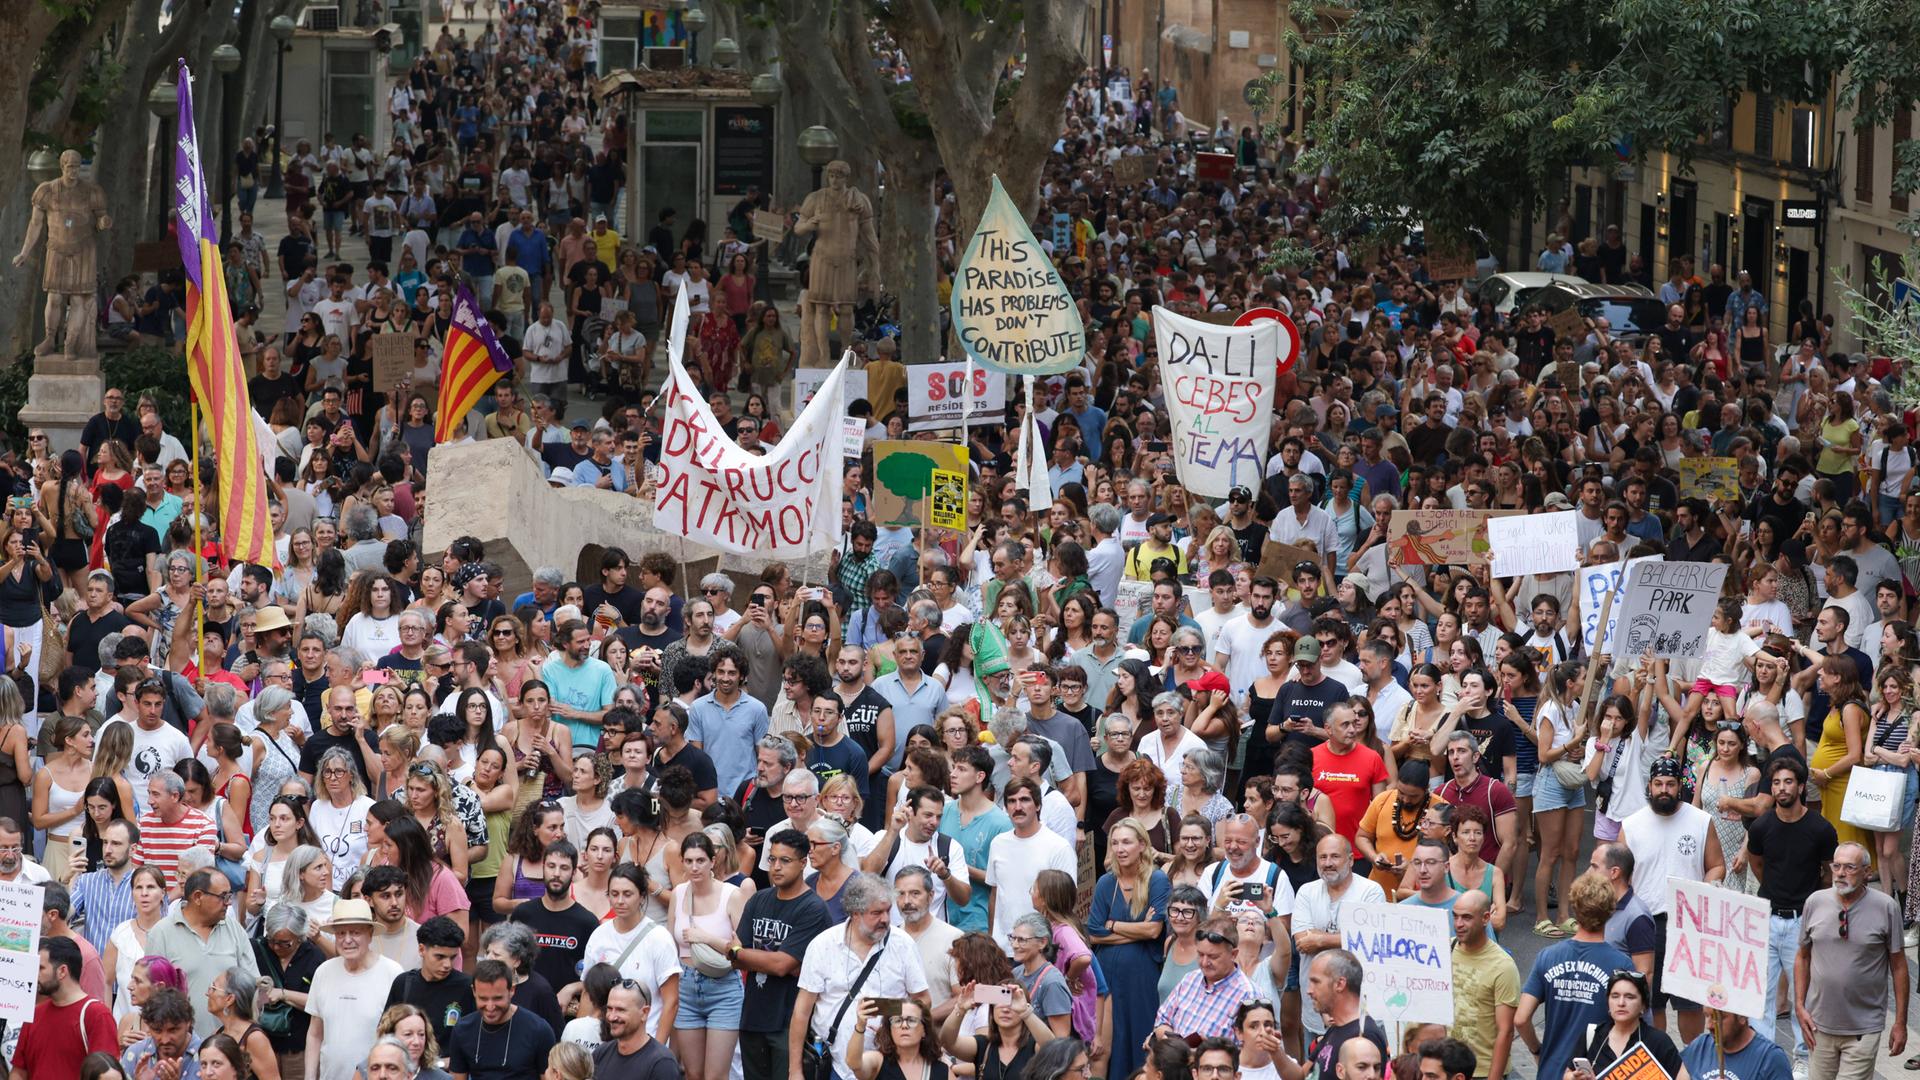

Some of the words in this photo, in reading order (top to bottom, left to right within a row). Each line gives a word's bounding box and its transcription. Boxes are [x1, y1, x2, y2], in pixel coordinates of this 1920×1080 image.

[960, 296, 995, 317] HAS
[1001, 293, 1069, 312] PROBLEMS
[995, 314, 1049, 331] DON'T
[928, 369, 987, 400] SOS
[1175, 376, 1263, 423] CEBES
[1192, 414, 1220, 434] AL
[1430, 510, 1454, 518] JORN
[1639, 563, 1722, 588] BALEARIC
[1648, 588, 1694, 614] PARK
[1291, 699, 1324, 707] PELOTON
[1855, 790, 1887, 802] MANGO
[322, 834, 350, 857] SOS
[1675, 888, 1766, 949] NUKE
[1347, 929, 1442, 968] MALLORCA
[1544, 963, 1565, 984] DEUS
[1565, 961, 1576, 973] EX
[1668, 932, 1762, 995] AENA
[1386, 972, 1397, 988] LA
[1553, 978, 1601, 993] MOTORCYCLES
